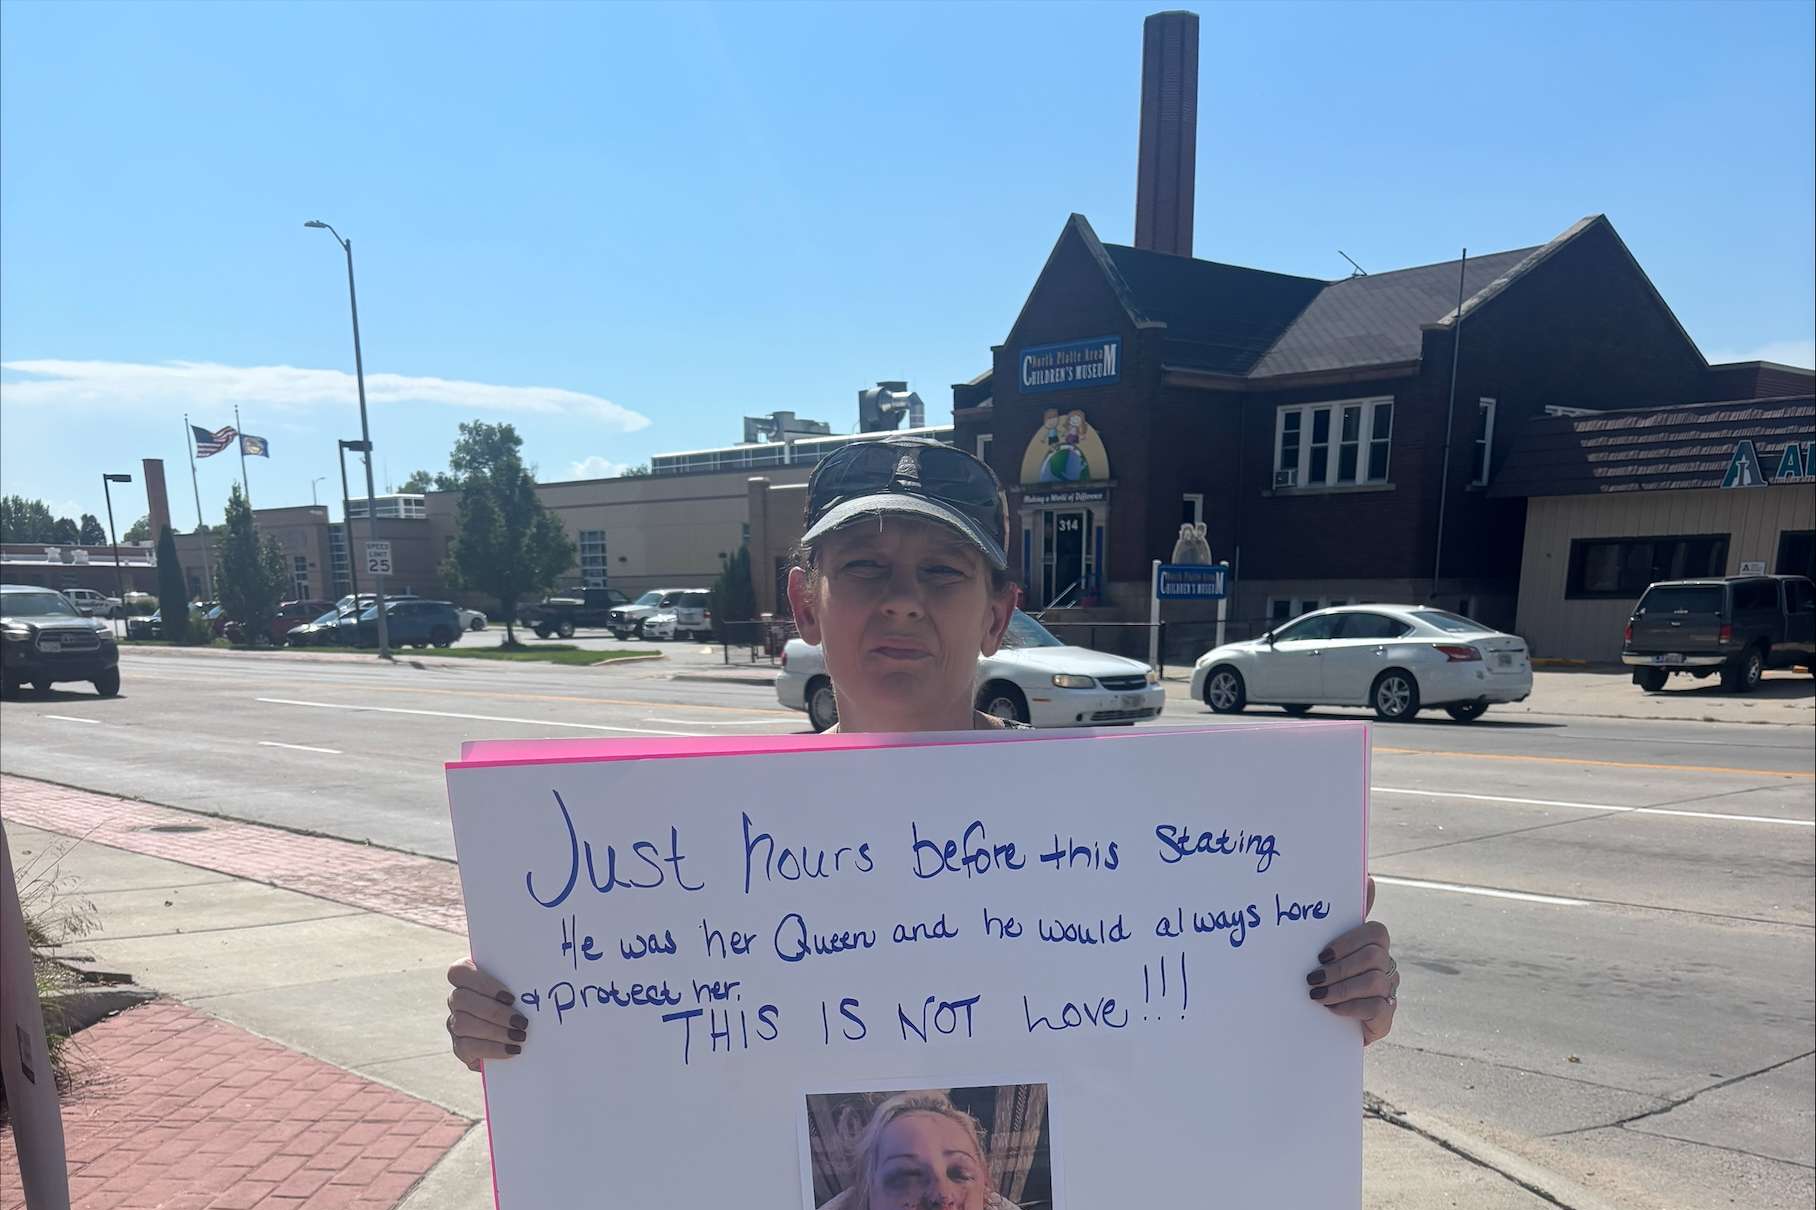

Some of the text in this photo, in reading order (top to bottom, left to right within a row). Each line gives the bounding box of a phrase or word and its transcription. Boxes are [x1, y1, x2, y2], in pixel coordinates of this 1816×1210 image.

[1075, 344, 1117, 380] MUSEUM
[1058, 520, 1079, 531] 314
[369, 559, 390, 572] 25
[526, 788, 705, 907] Just
[741, 810, 875, 896] hours
[911, 820, 1027, 881] before
[1039, 833, 1119, 871] this
[557, 914, 604, 971] He
[620, 929, 678, 961] was
[702, 918, 758, 959] her
[774, 912, 877, 963] Queen
[893, 912, 959, 944] and
[983, 907, 1023, 941] he
[1039, 914, 1132, 945] would
[661, 1004, 779, 1066] THIS
[821, 997, 868, 1046] IS
[897, 994, 982, 1044] NOT
